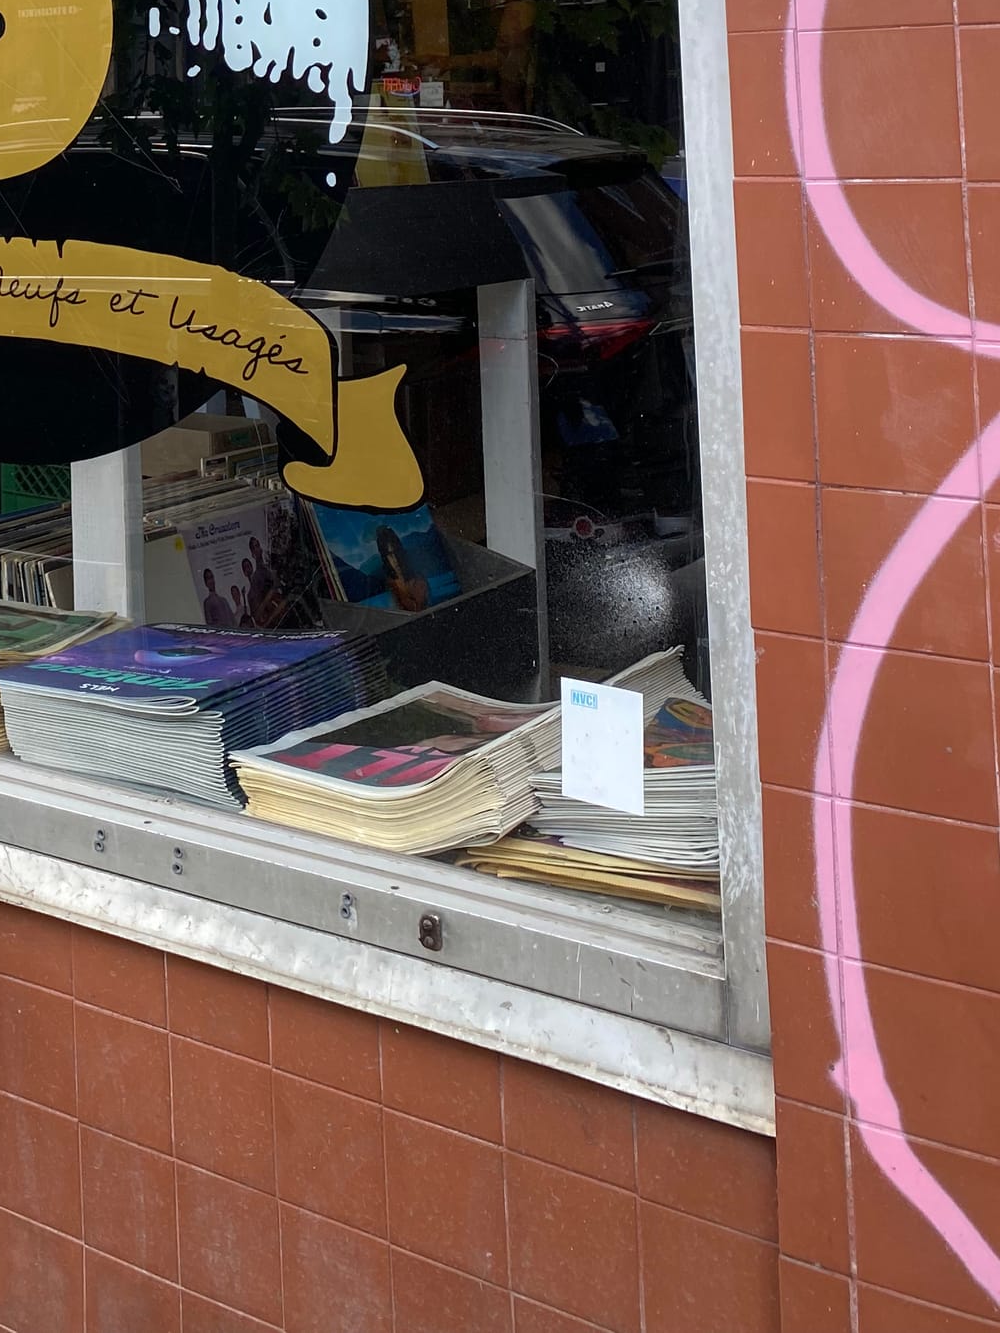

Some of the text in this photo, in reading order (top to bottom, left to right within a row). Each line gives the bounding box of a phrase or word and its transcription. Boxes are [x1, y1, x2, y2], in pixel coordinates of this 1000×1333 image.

[109, 287, 160, 316] et
[168, 294, 309, 382] Usagés
[78, 682, 121, 693] MELS
